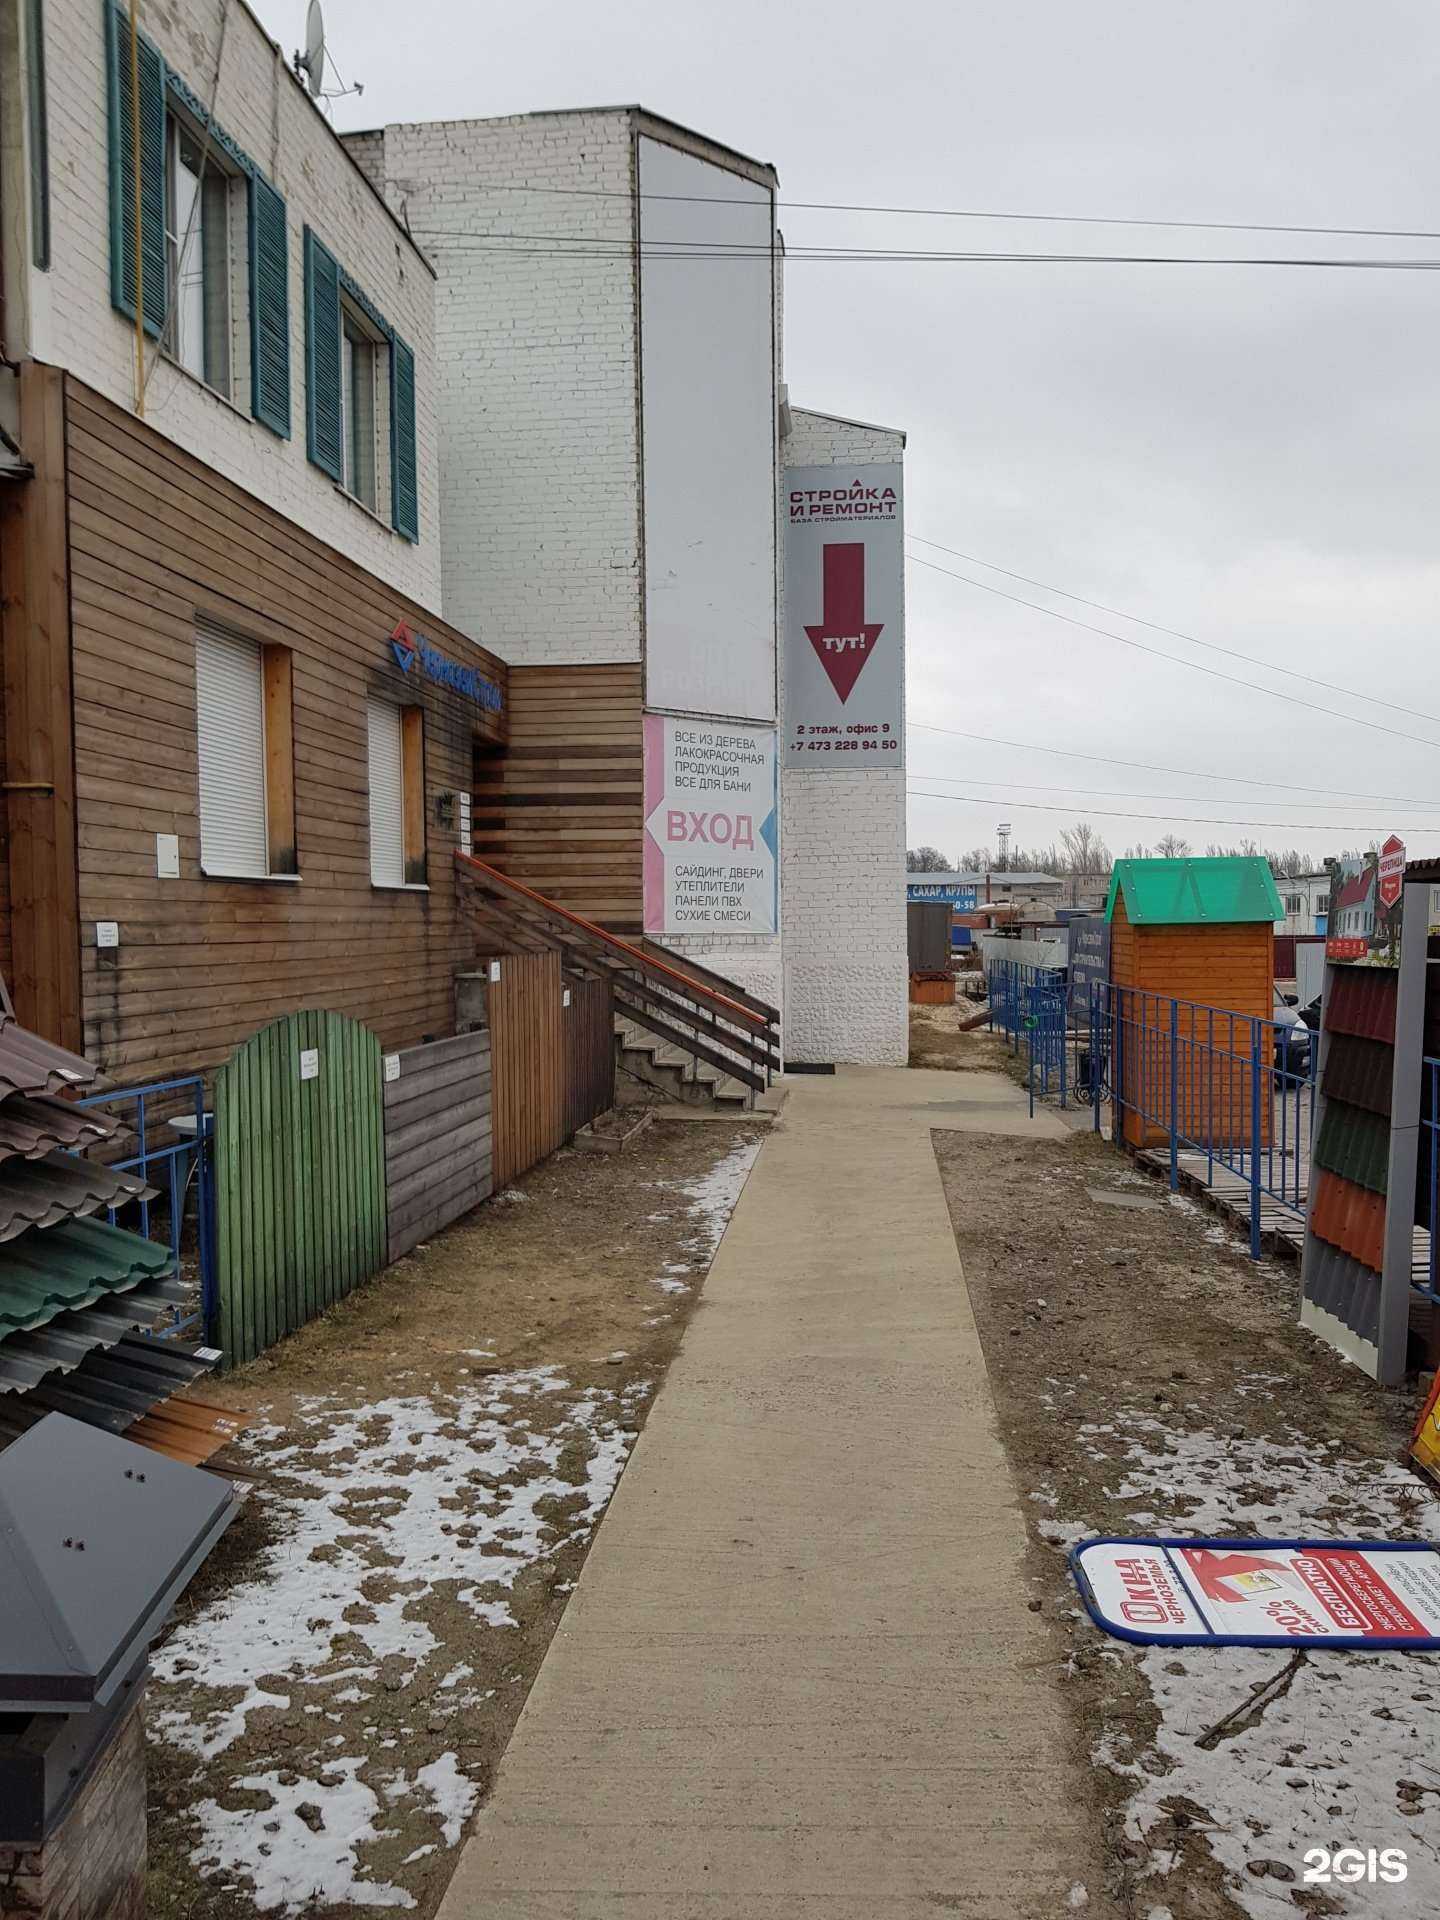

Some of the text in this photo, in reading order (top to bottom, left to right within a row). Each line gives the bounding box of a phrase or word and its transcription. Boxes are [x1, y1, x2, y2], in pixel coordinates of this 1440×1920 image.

[789, 480, 897, 503] СТРОЙКА
[789, 501, 897, 517] И РЕМОНТ
[814, 514, 896, 524] СТРОЙМАТЕРИАЛОВ
[796, 723, 890, 735] 2 этаж, офис 9
[674, 730, 757, 750] ВСЕ ИЗ ДЕРЕВА
[790, 740, 898, 751] +7 473 228 94 50
[674, 745, 765, 765] ЛАКОКРАСОЧНАЯ
[674, 760, 740, 777] ПРОДУКЦИЯ
[674, 775, 752, 793] ВСЕ ДЛЯ БАНИ
[666, 810, 754, 851] ВХОД
[674, 863, 764, 880] САЙДИНГ, ДВЕРИ
[674, 880, 745, 893] УТЕПЛИТЕЛИ
[912, 884, 944, 898] САХАР,
[945, 883, 976, 897] КРУПЫ
[674, 895, 742, 907] ПАНЕЛИ ПВХ
[674, 909, 751, 921] СУХИЕ СМЕСИ
[1113, 1558, 1169, 1624] ОКНА
[1143, 1558, 1188, 1624] ЧЕРНОЗЕМЬЯ
[1296, 1559, 1361, 1626] БЕСПЛАТНО
[1259, 1600, 1317, 1635] 20%
[1282, 1599, 1330, 1634] скидка
[1366, 1585, 1416, 1632] СТЕКЛОПАКЕТ
